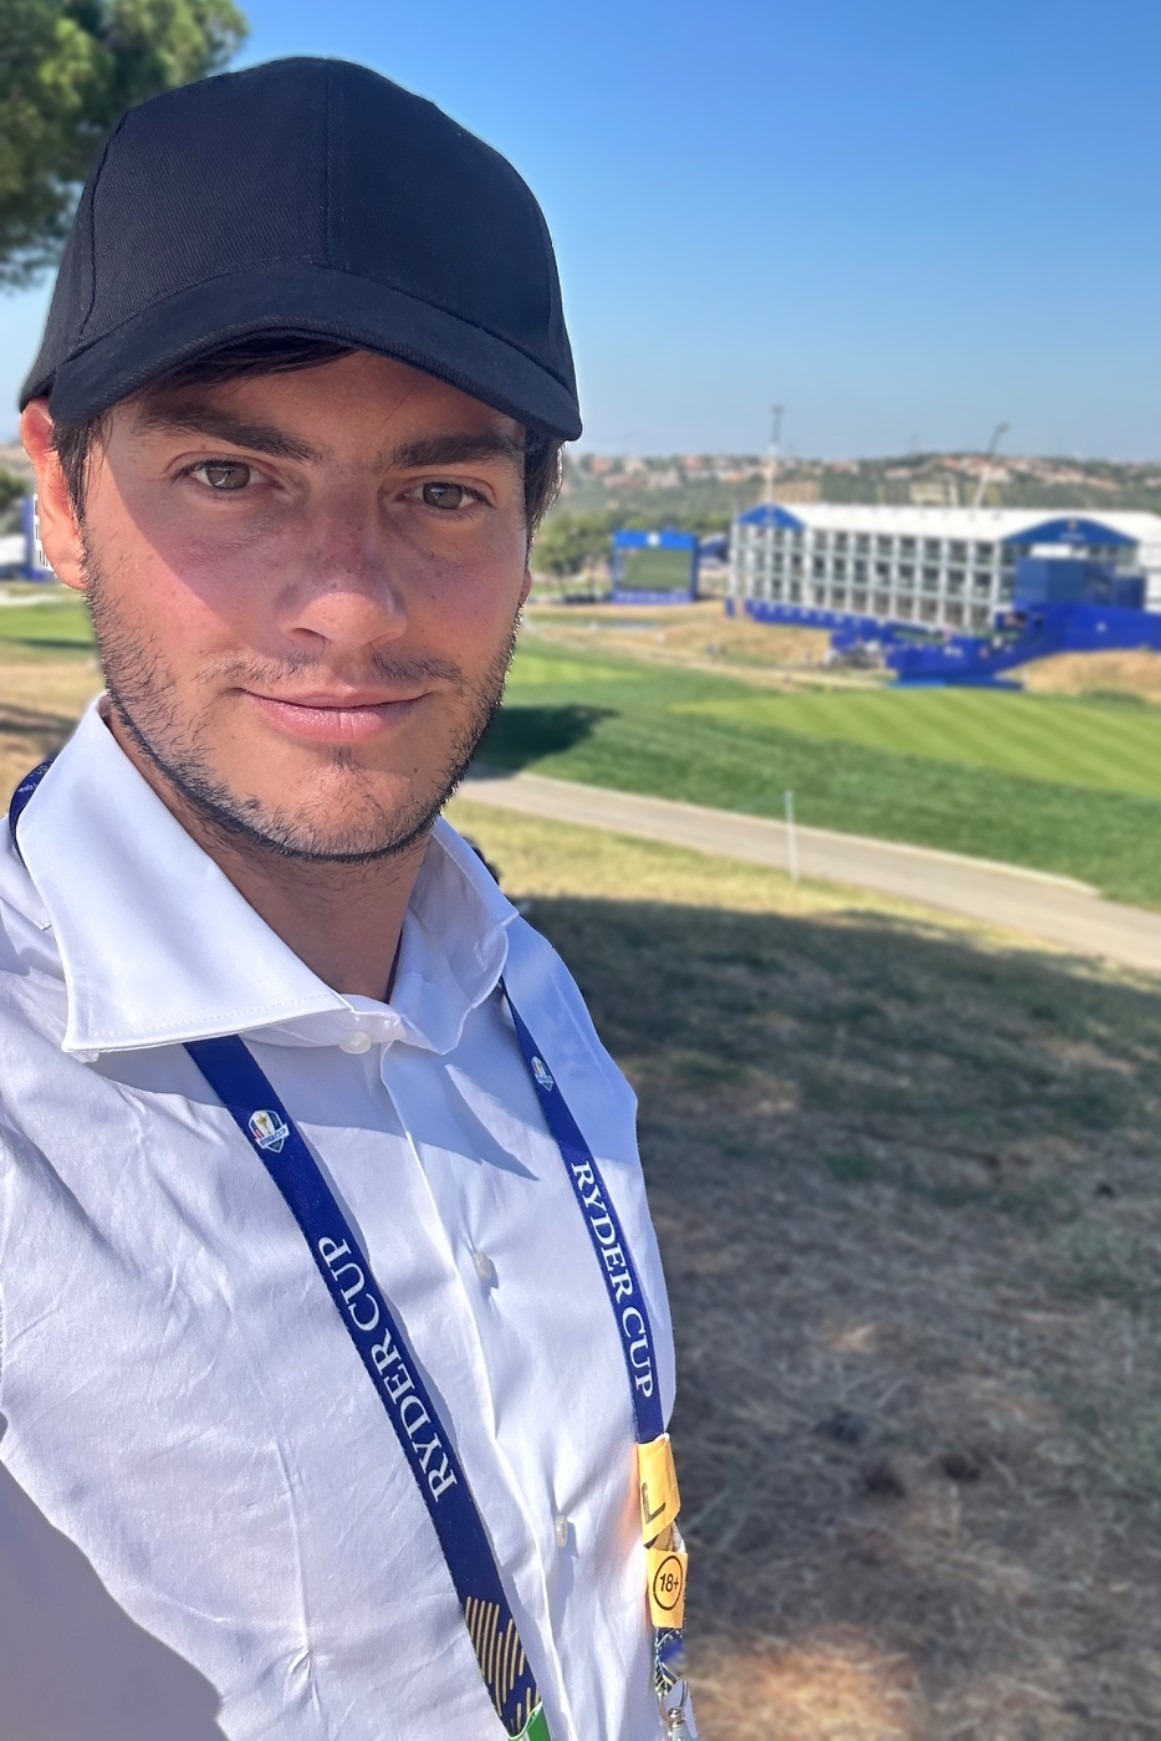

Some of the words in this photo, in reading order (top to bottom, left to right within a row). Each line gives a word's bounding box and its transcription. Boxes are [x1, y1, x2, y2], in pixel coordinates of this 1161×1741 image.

[319, 1237, 380, 1331] CUP
[572, 1161, 634, 1303] RYDER
[622, 1306, 653, 1398] CUP
[371, 1329, 458, 1502] RYDER
[660, 1573, 680, 1593] 18+
